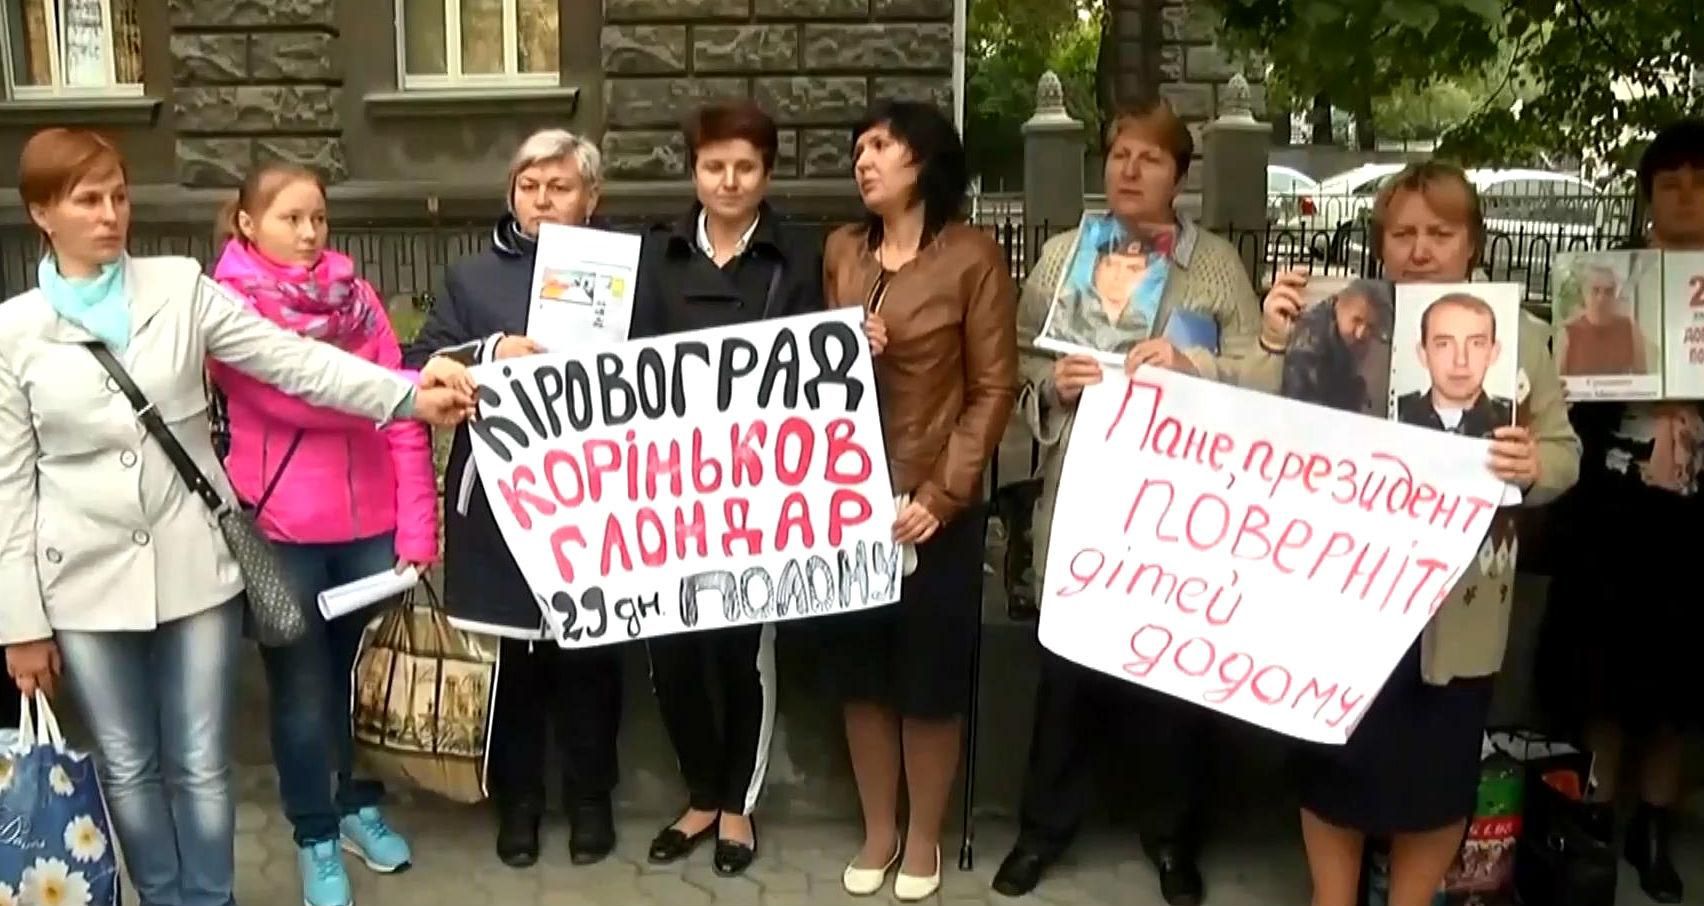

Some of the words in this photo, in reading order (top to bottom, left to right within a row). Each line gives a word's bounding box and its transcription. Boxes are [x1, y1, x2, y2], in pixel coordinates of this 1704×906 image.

[1243, 440, 1494, 533] президент
[549, 489, 872, 583] ГЛОНДАР
[1057, 547, 1243, 625] дітей
